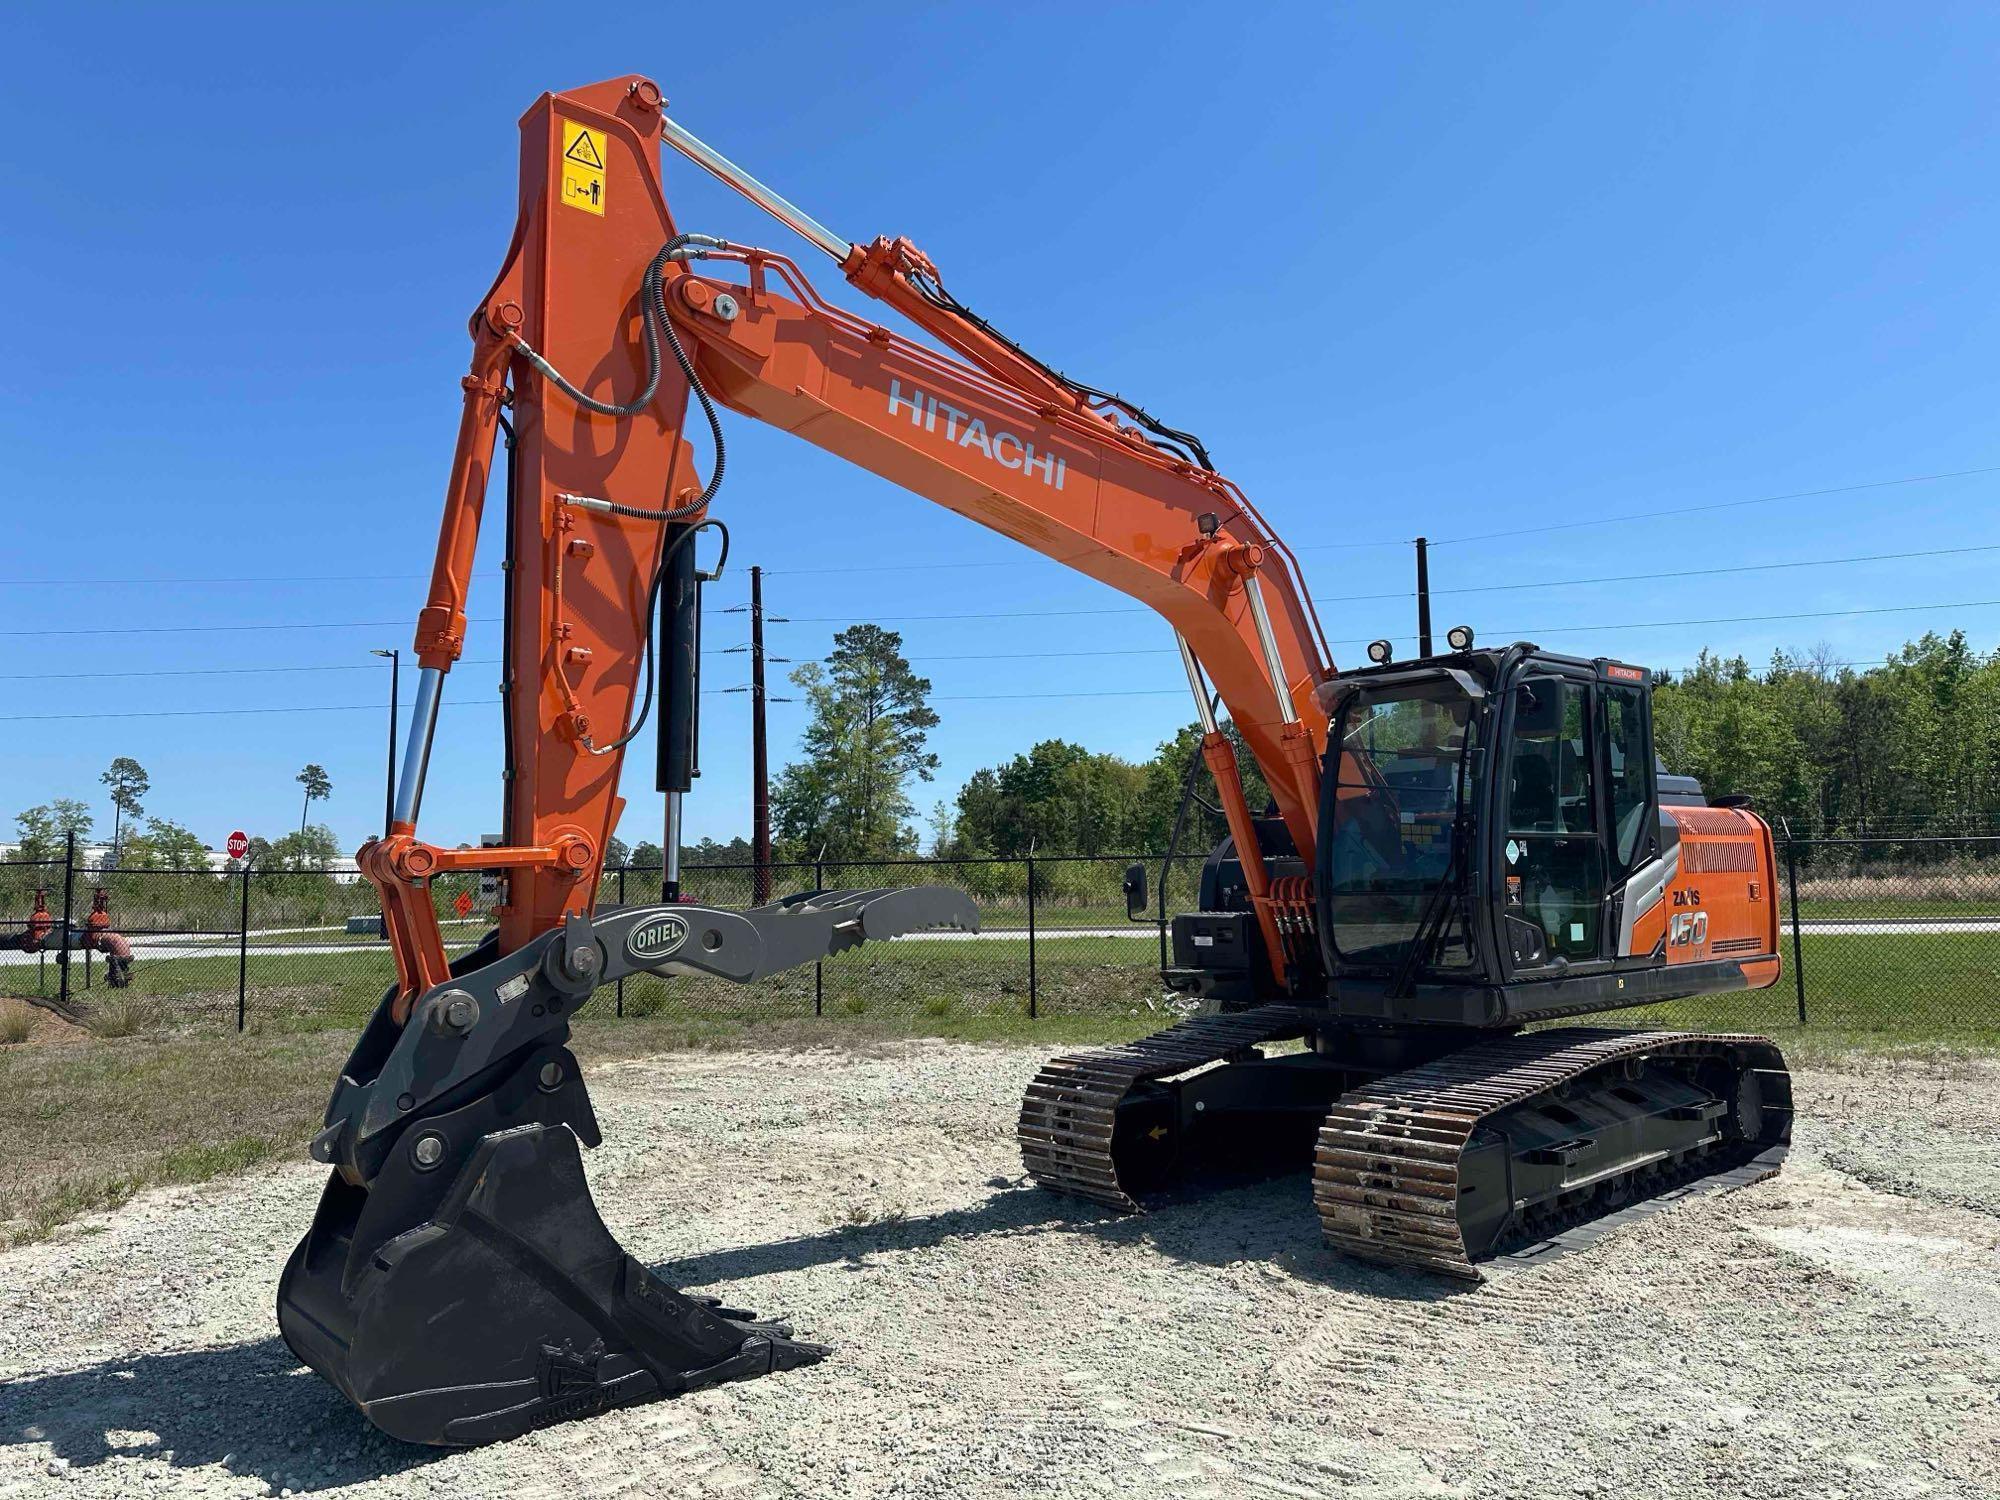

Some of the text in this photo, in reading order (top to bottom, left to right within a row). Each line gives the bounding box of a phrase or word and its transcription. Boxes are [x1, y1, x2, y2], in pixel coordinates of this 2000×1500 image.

[888, 379, 1067, 491] HITACHI
[228, 839, 247, 851] STOP
[1673, 887, 1700, 907] ZAXIS
[1670, 911, 1708, 947] 160
